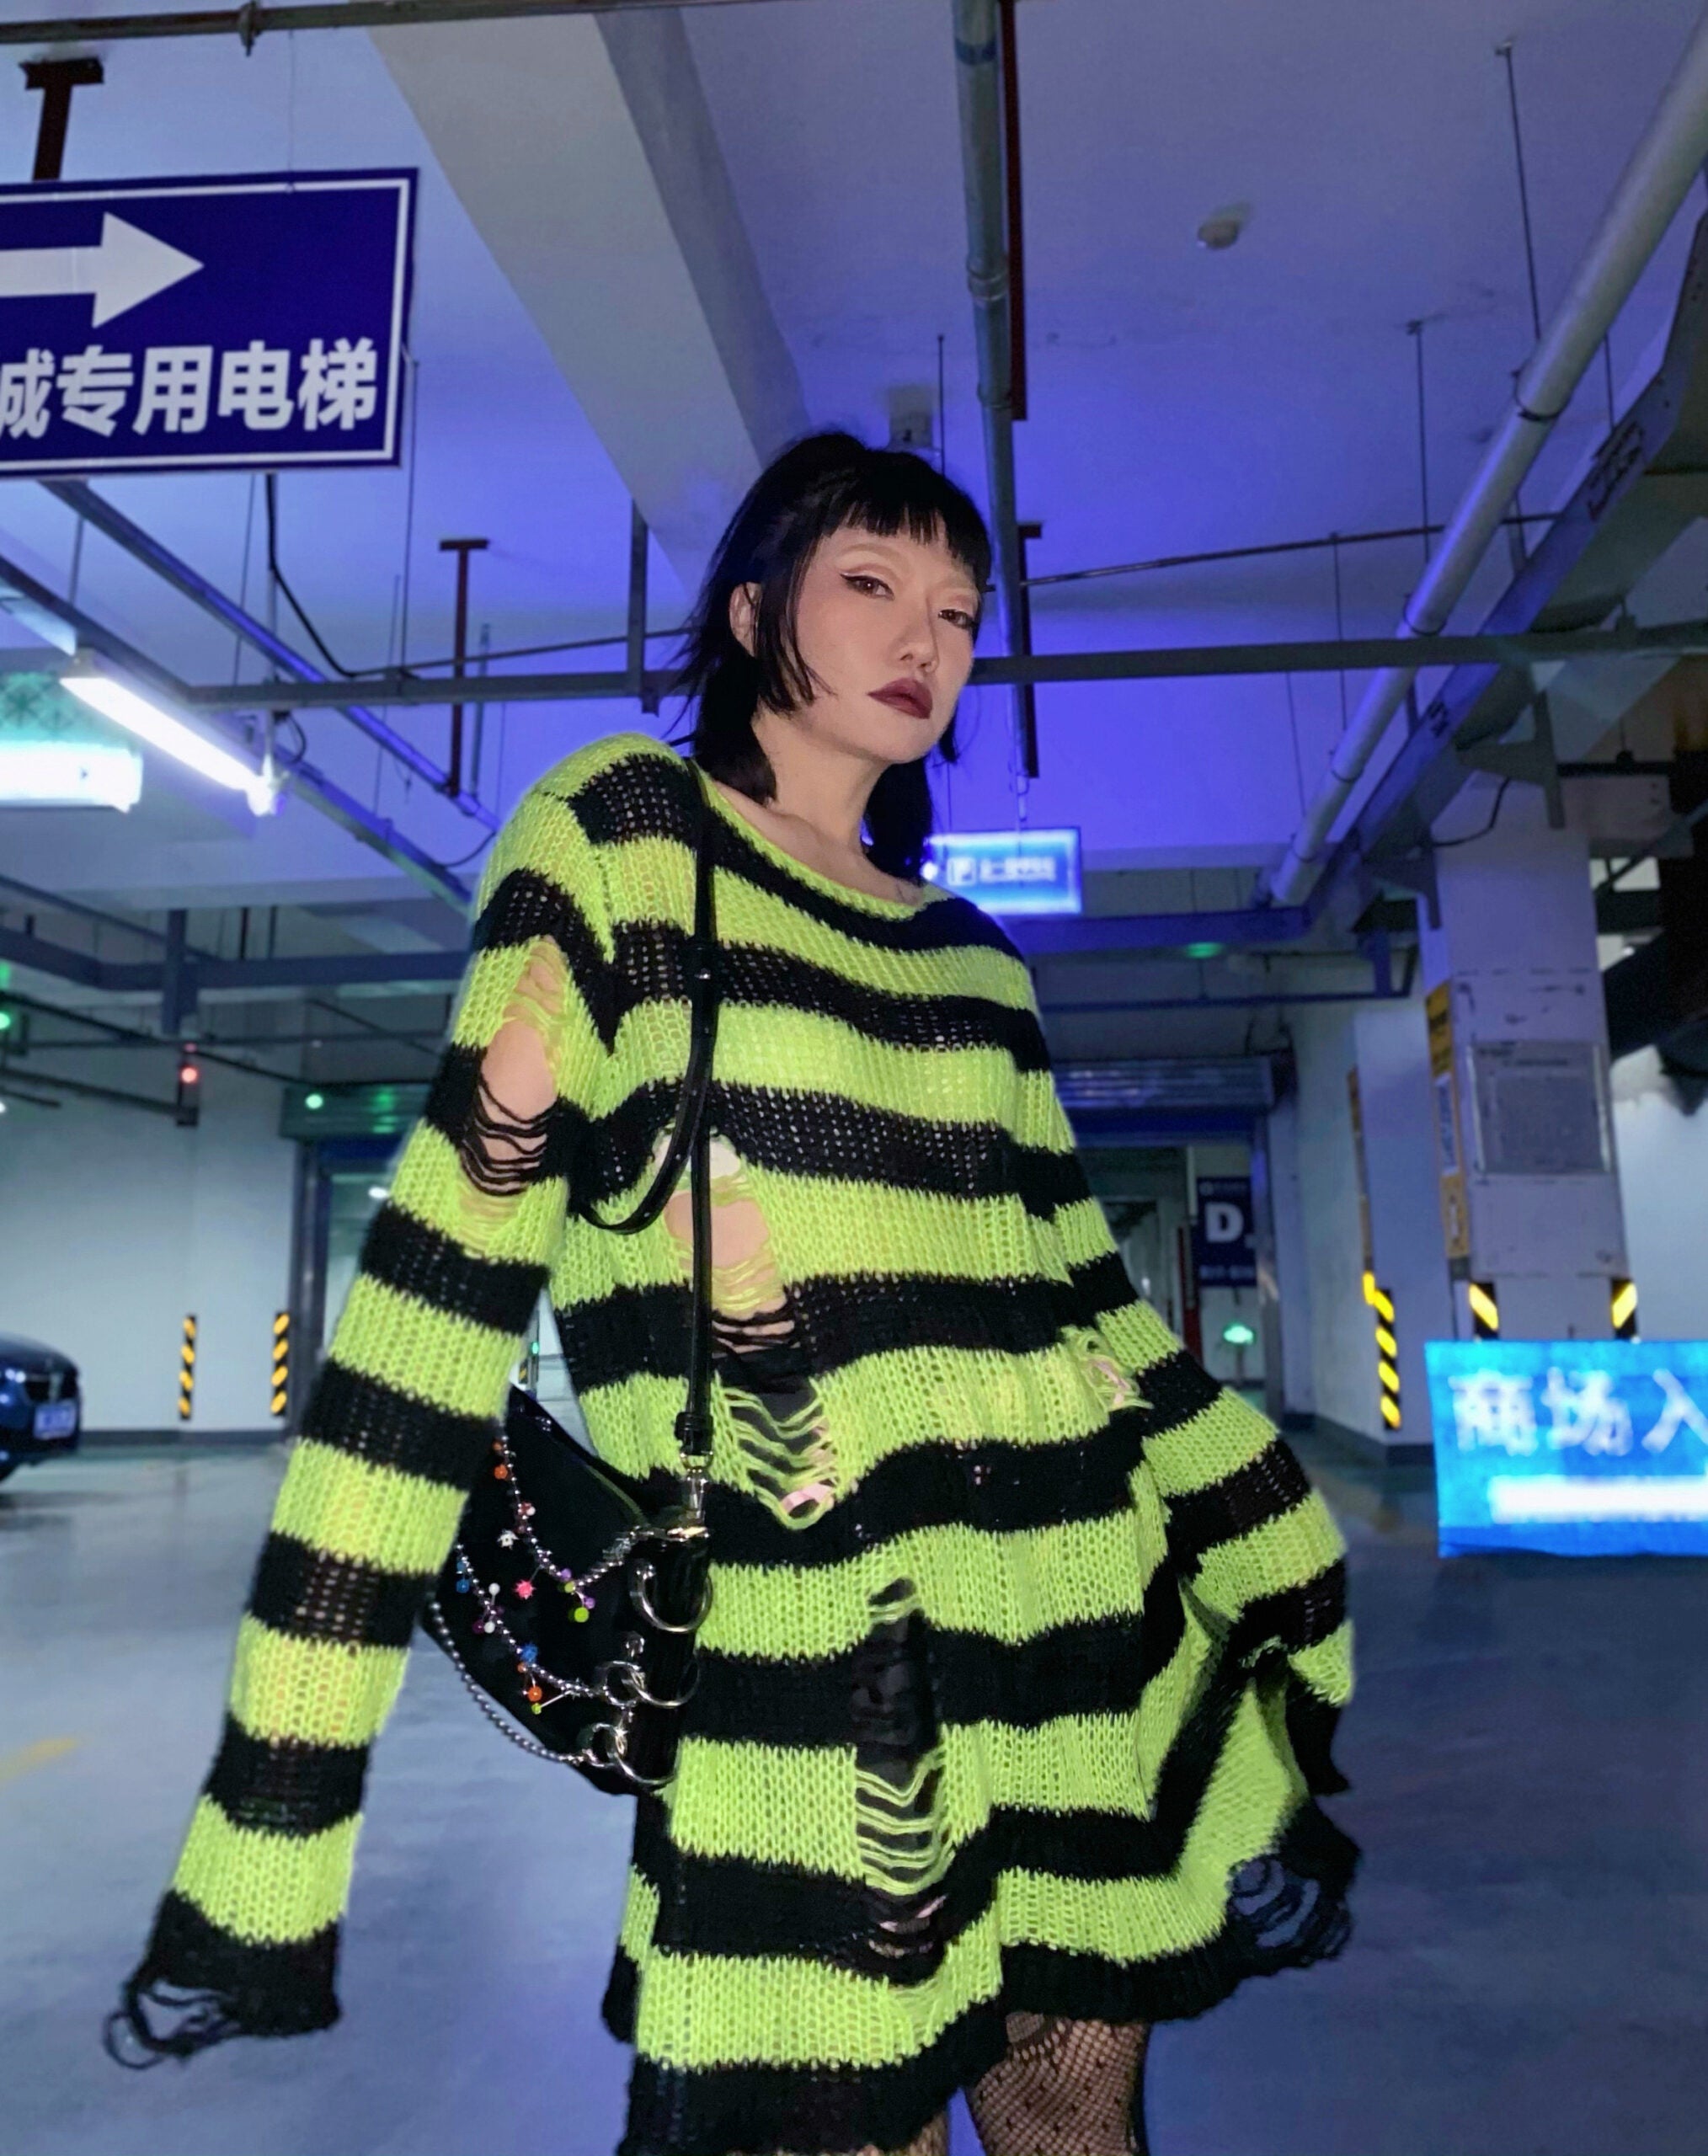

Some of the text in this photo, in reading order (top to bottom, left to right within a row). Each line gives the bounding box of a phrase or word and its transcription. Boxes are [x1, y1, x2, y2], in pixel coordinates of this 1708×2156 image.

[1205, 1202, 1243, 1242] D
[1448, 1366, 1708, 1456] 商场入
